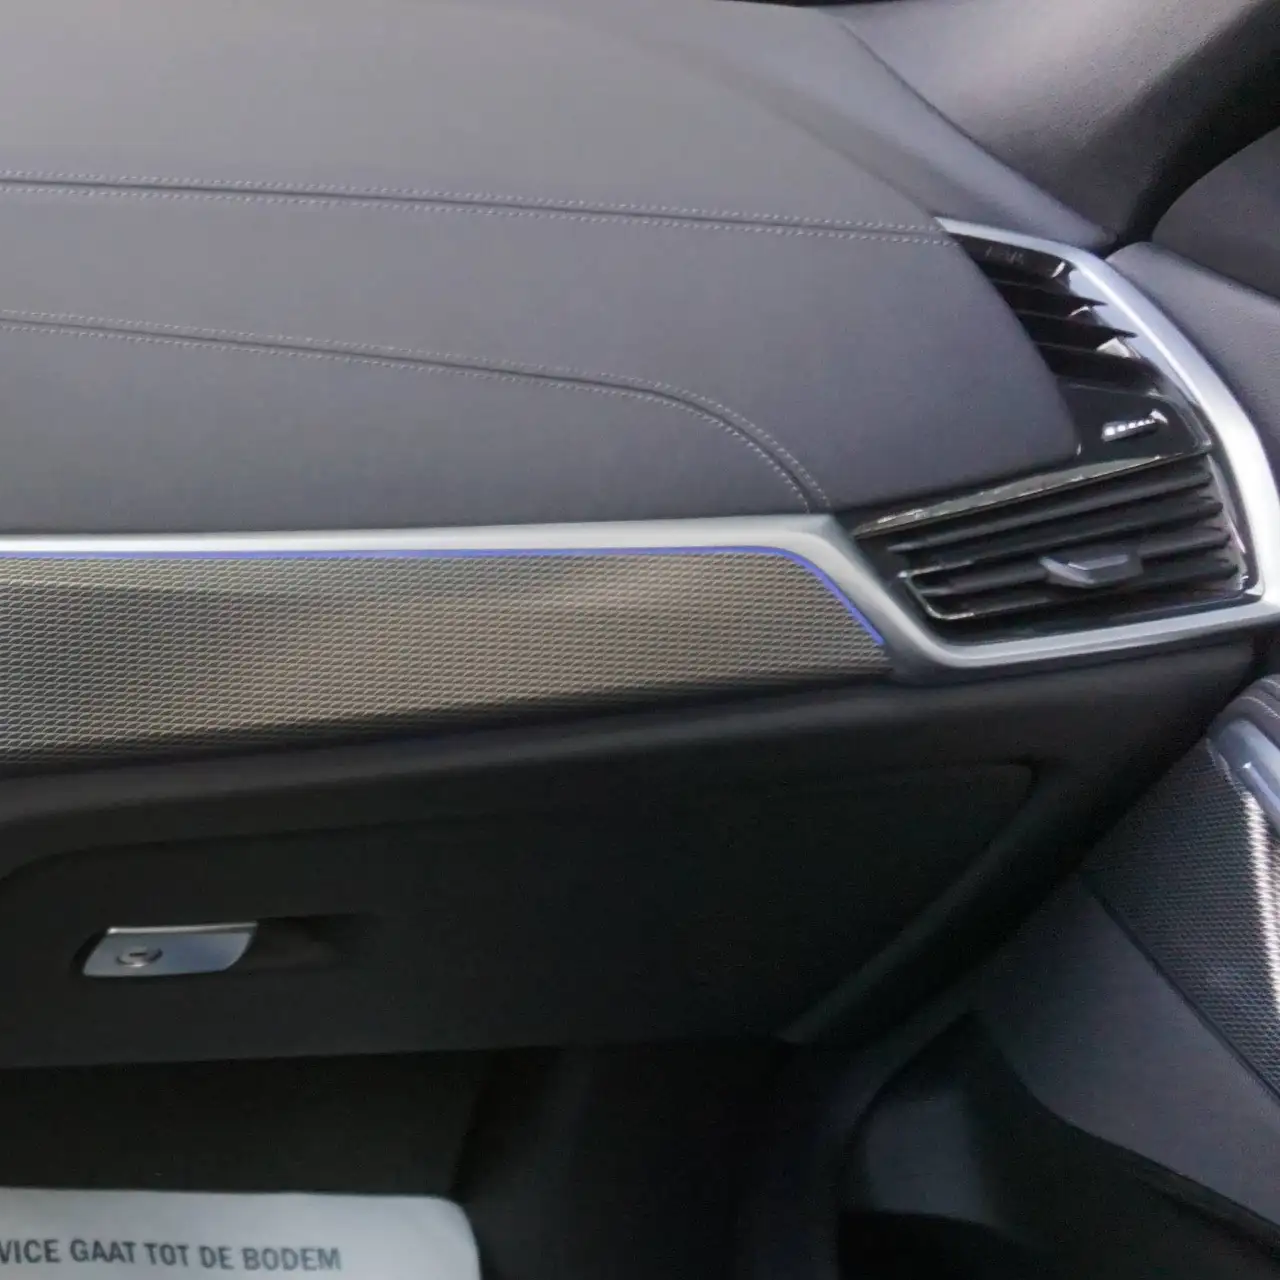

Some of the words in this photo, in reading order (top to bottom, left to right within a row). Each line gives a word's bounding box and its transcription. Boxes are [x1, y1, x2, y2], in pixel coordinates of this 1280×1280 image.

[69, 1238, 137, 1265] GAAT
[144, 1242, 190, 1268] TOT
[200, 1245, 235, 1271] DE
[243, 1246, 342, 1272] BODEM
